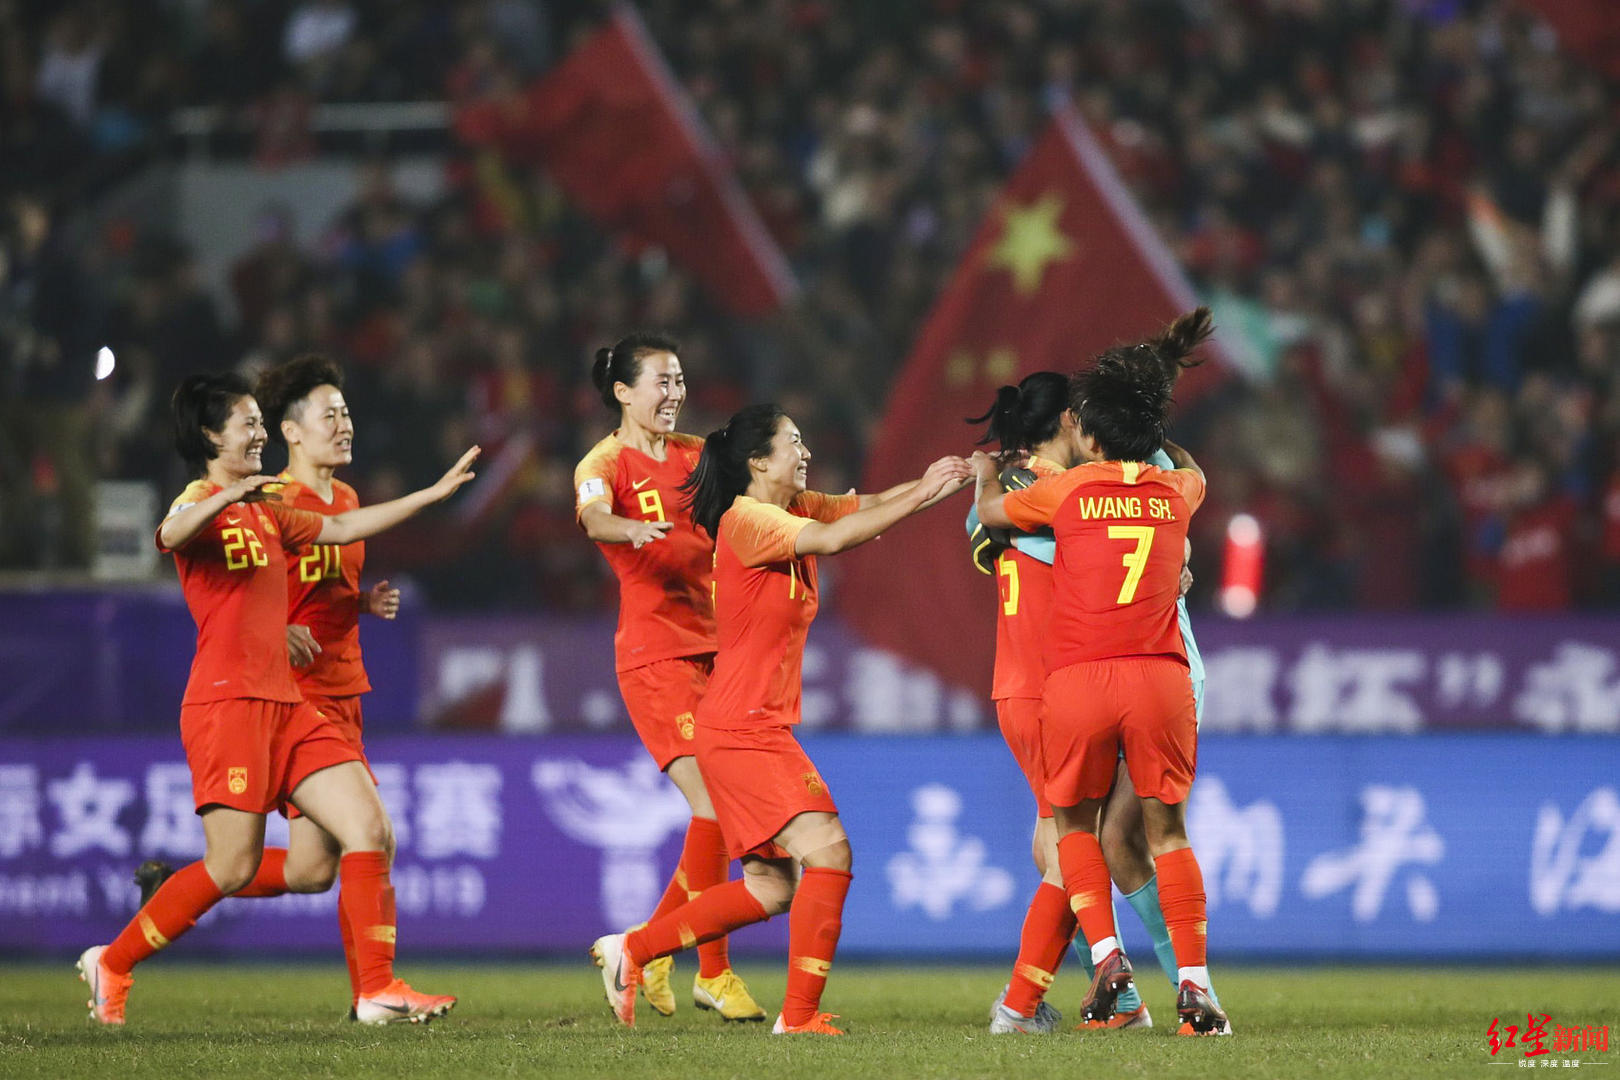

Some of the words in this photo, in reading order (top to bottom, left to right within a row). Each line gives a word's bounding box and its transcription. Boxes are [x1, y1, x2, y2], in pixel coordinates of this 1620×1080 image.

[637, 489, 667, 523] 9
[1079, 497, 1142, 519] WANG
[221, 527, 269, 571] 22
[300, 544, 341, 583] 20
[1107, 525, 1156, 605] 7
